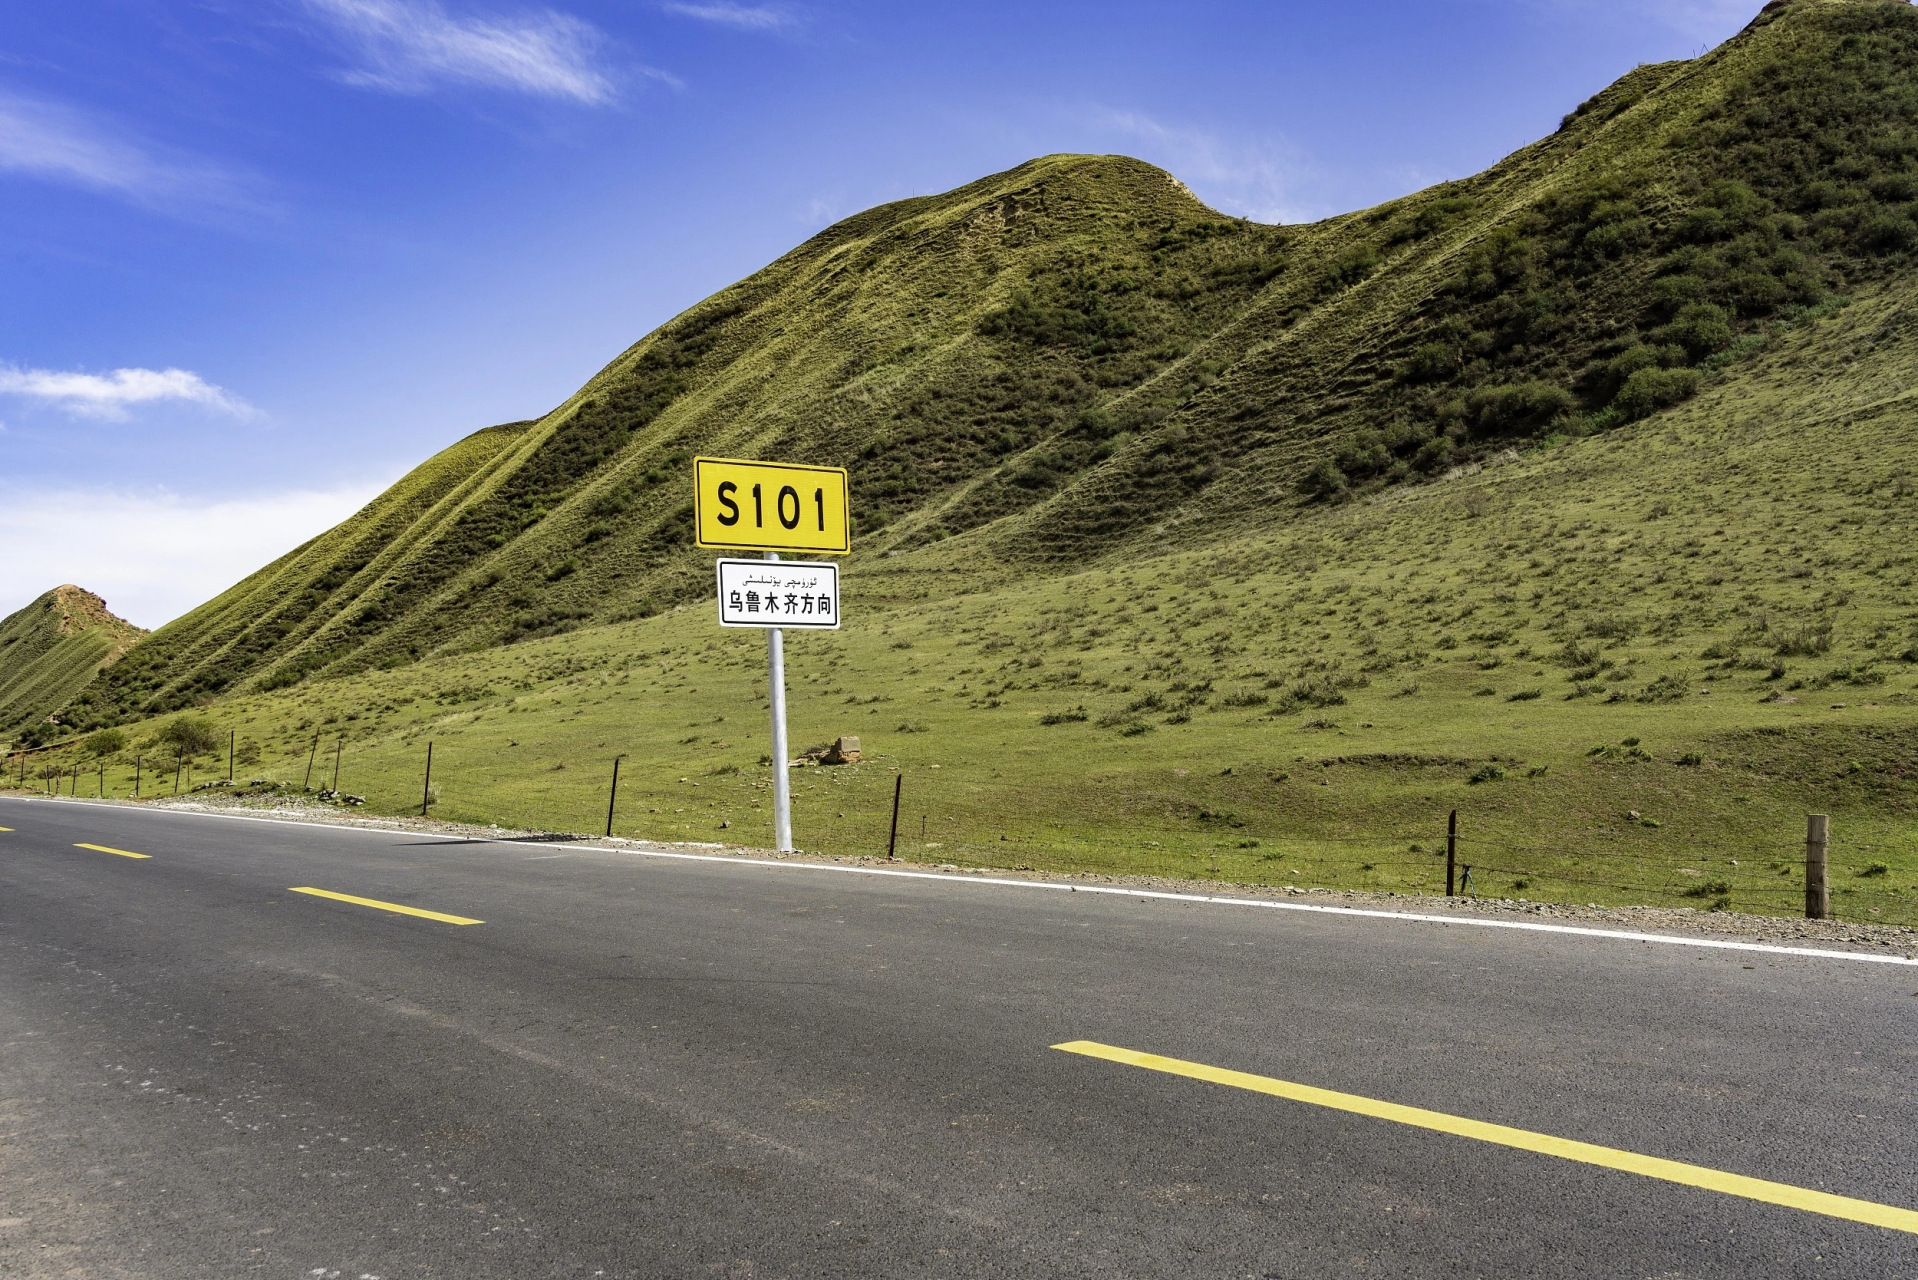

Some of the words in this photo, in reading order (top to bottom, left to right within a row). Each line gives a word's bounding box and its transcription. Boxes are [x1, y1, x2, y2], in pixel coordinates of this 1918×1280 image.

[716, 481, 825, 532] S101
[729, 589, 831, 615] 乌鲁木齐方向
